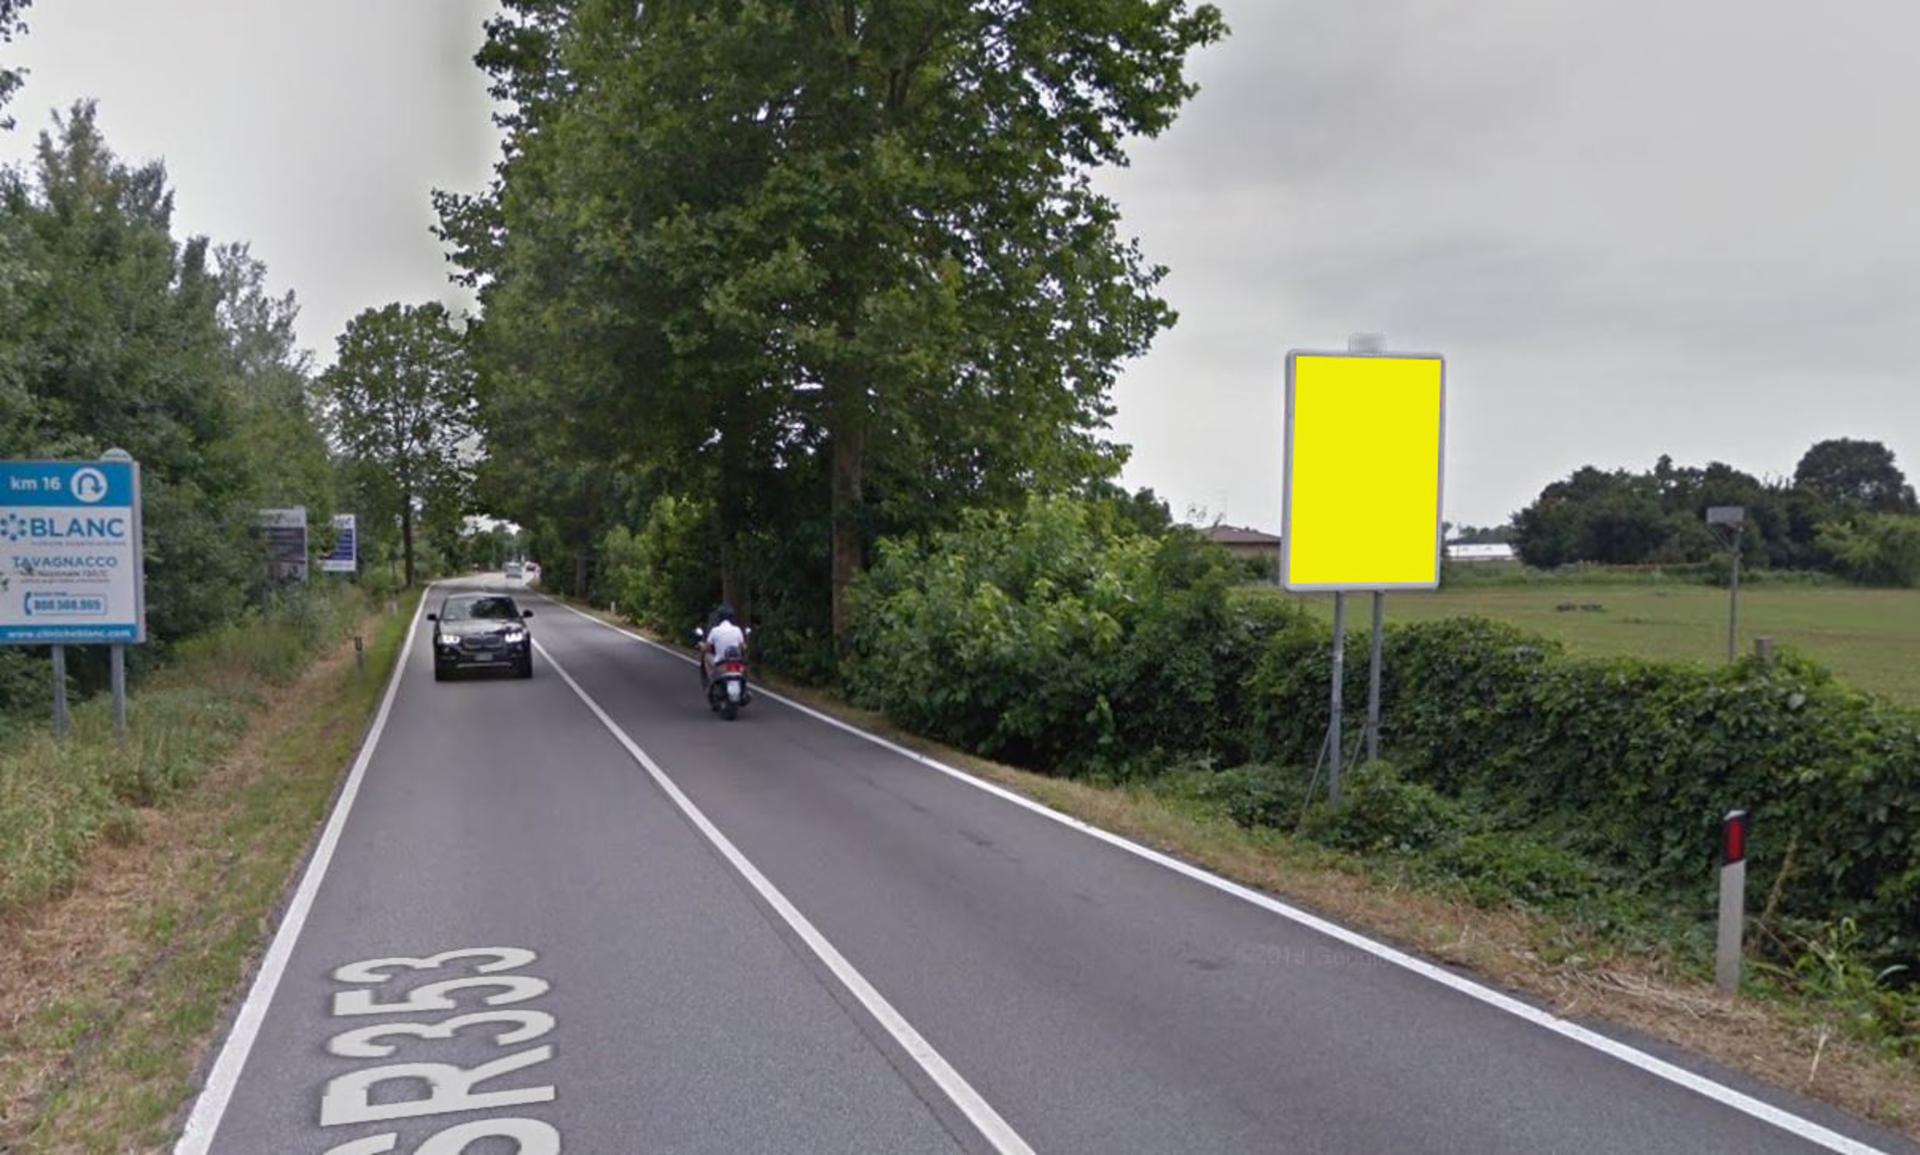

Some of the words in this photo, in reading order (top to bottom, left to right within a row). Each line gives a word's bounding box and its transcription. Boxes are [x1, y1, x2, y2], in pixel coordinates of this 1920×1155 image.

[10, 476, 38, 491] km
[42, 476, 61, 491] 16
[30, 517, 125, 538] BLANC
[12, 556, 118, 569] TAVAGNACCO
